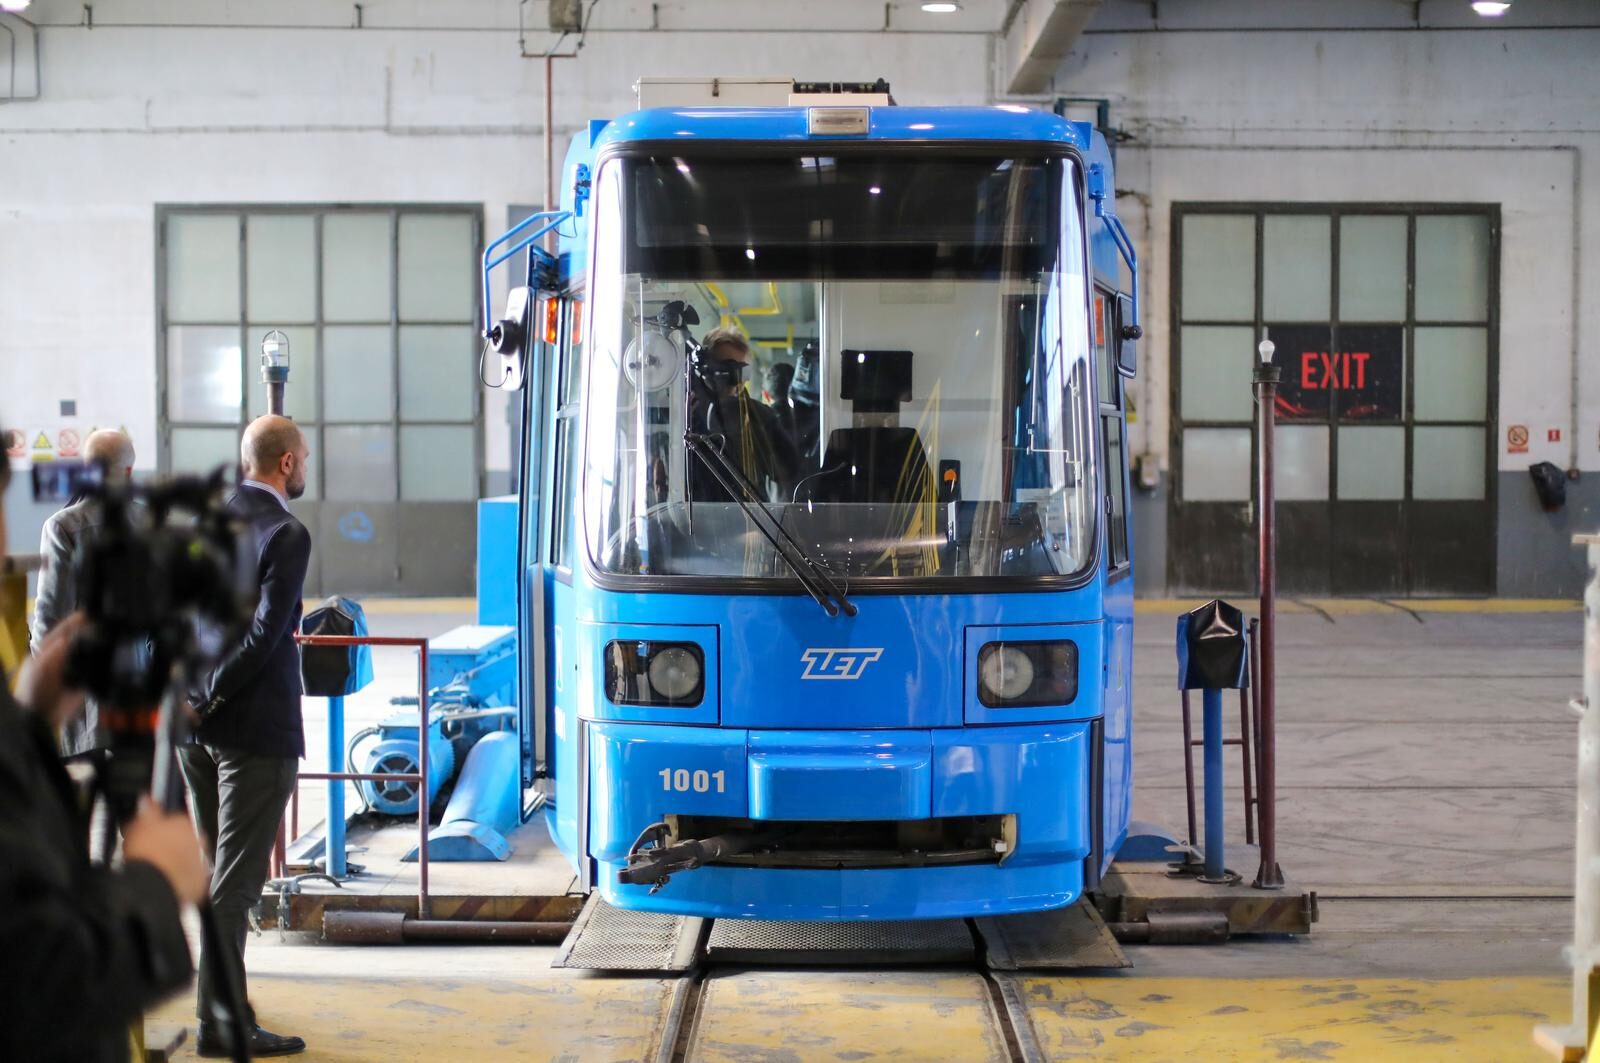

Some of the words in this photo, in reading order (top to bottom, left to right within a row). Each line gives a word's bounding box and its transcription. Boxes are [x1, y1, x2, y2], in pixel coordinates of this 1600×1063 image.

[1301, 351, 1370, 389] EXIT
[800, 647, 885, 680] ZET
[658, 767, 725, 793] 1001
